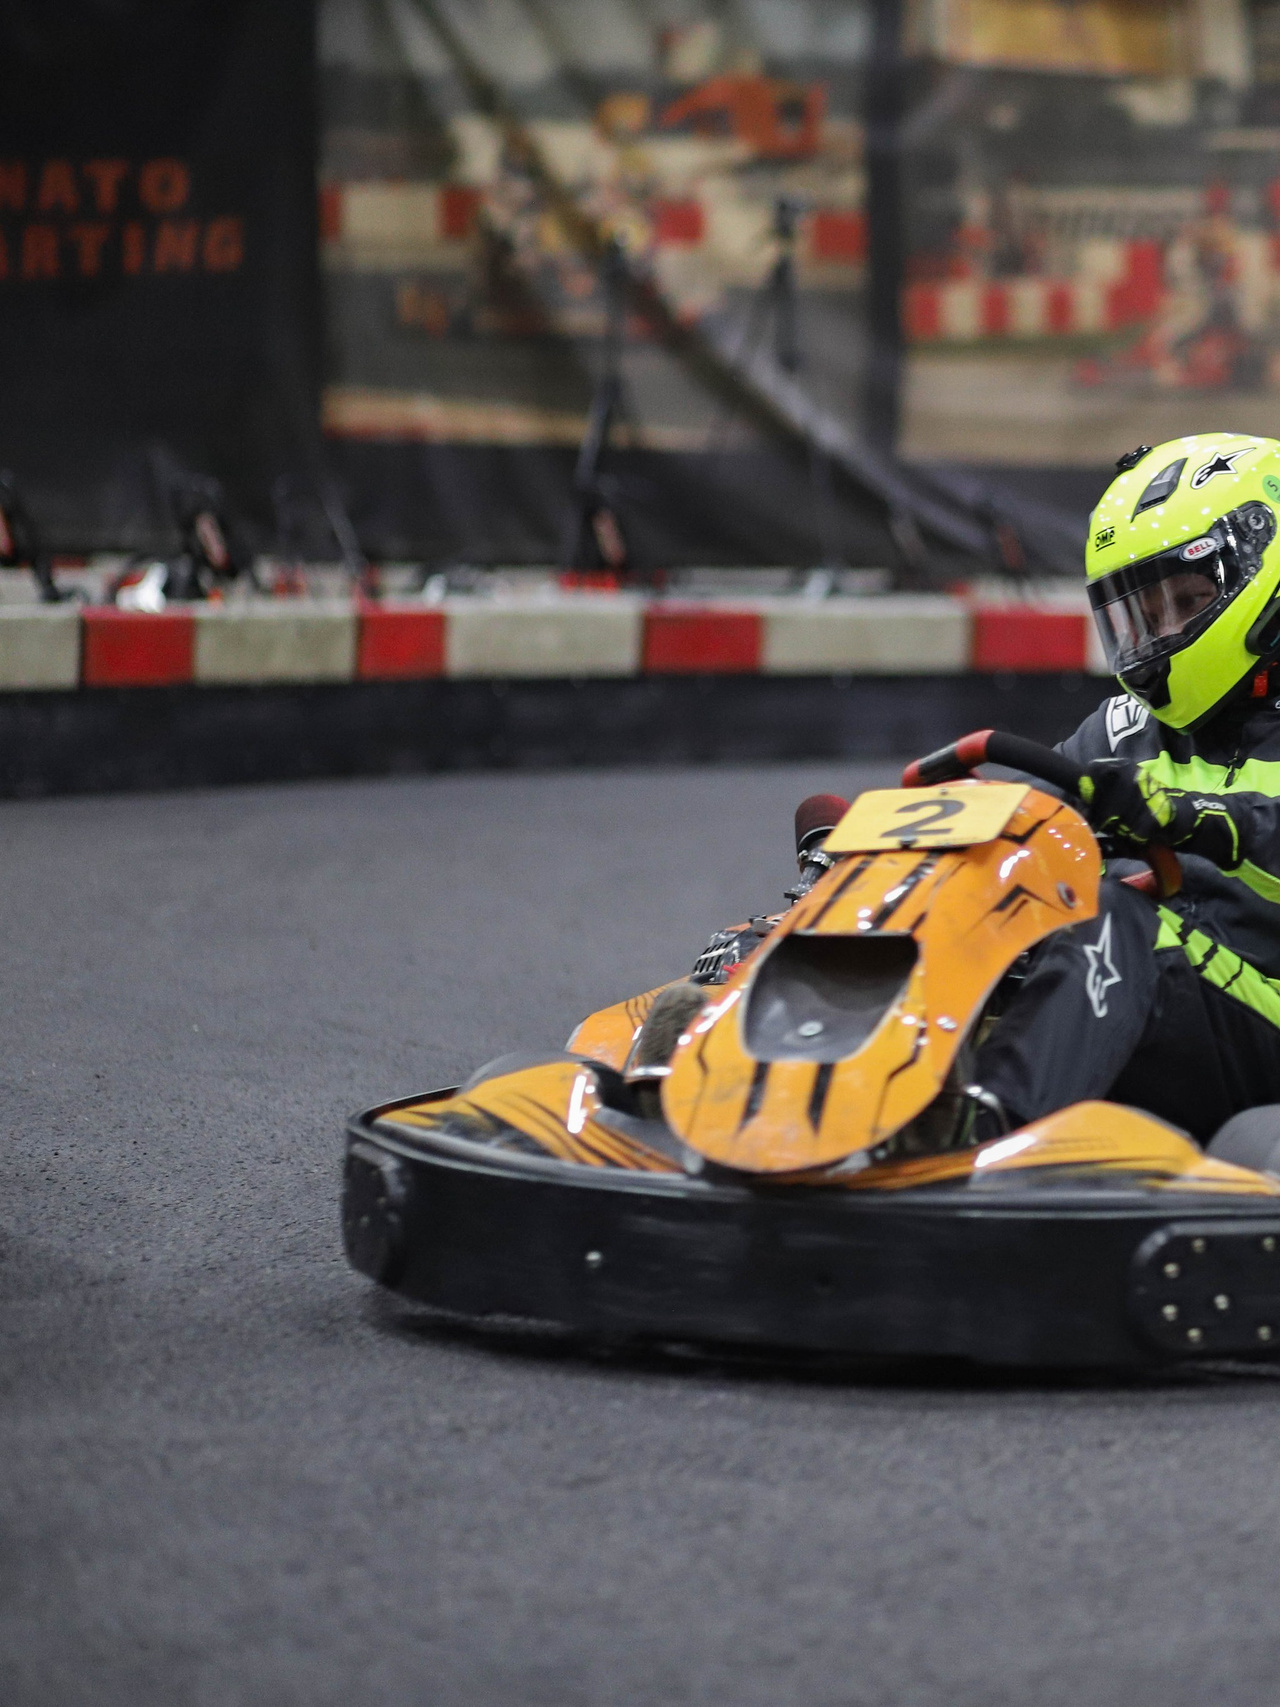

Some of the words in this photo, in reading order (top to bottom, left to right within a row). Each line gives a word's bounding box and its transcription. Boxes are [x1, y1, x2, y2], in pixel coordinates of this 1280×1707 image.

[0, 215, 243, 280] RTING
[1187, 541, 1211, 556] BELL
[879, 799, 966, 838] 2
